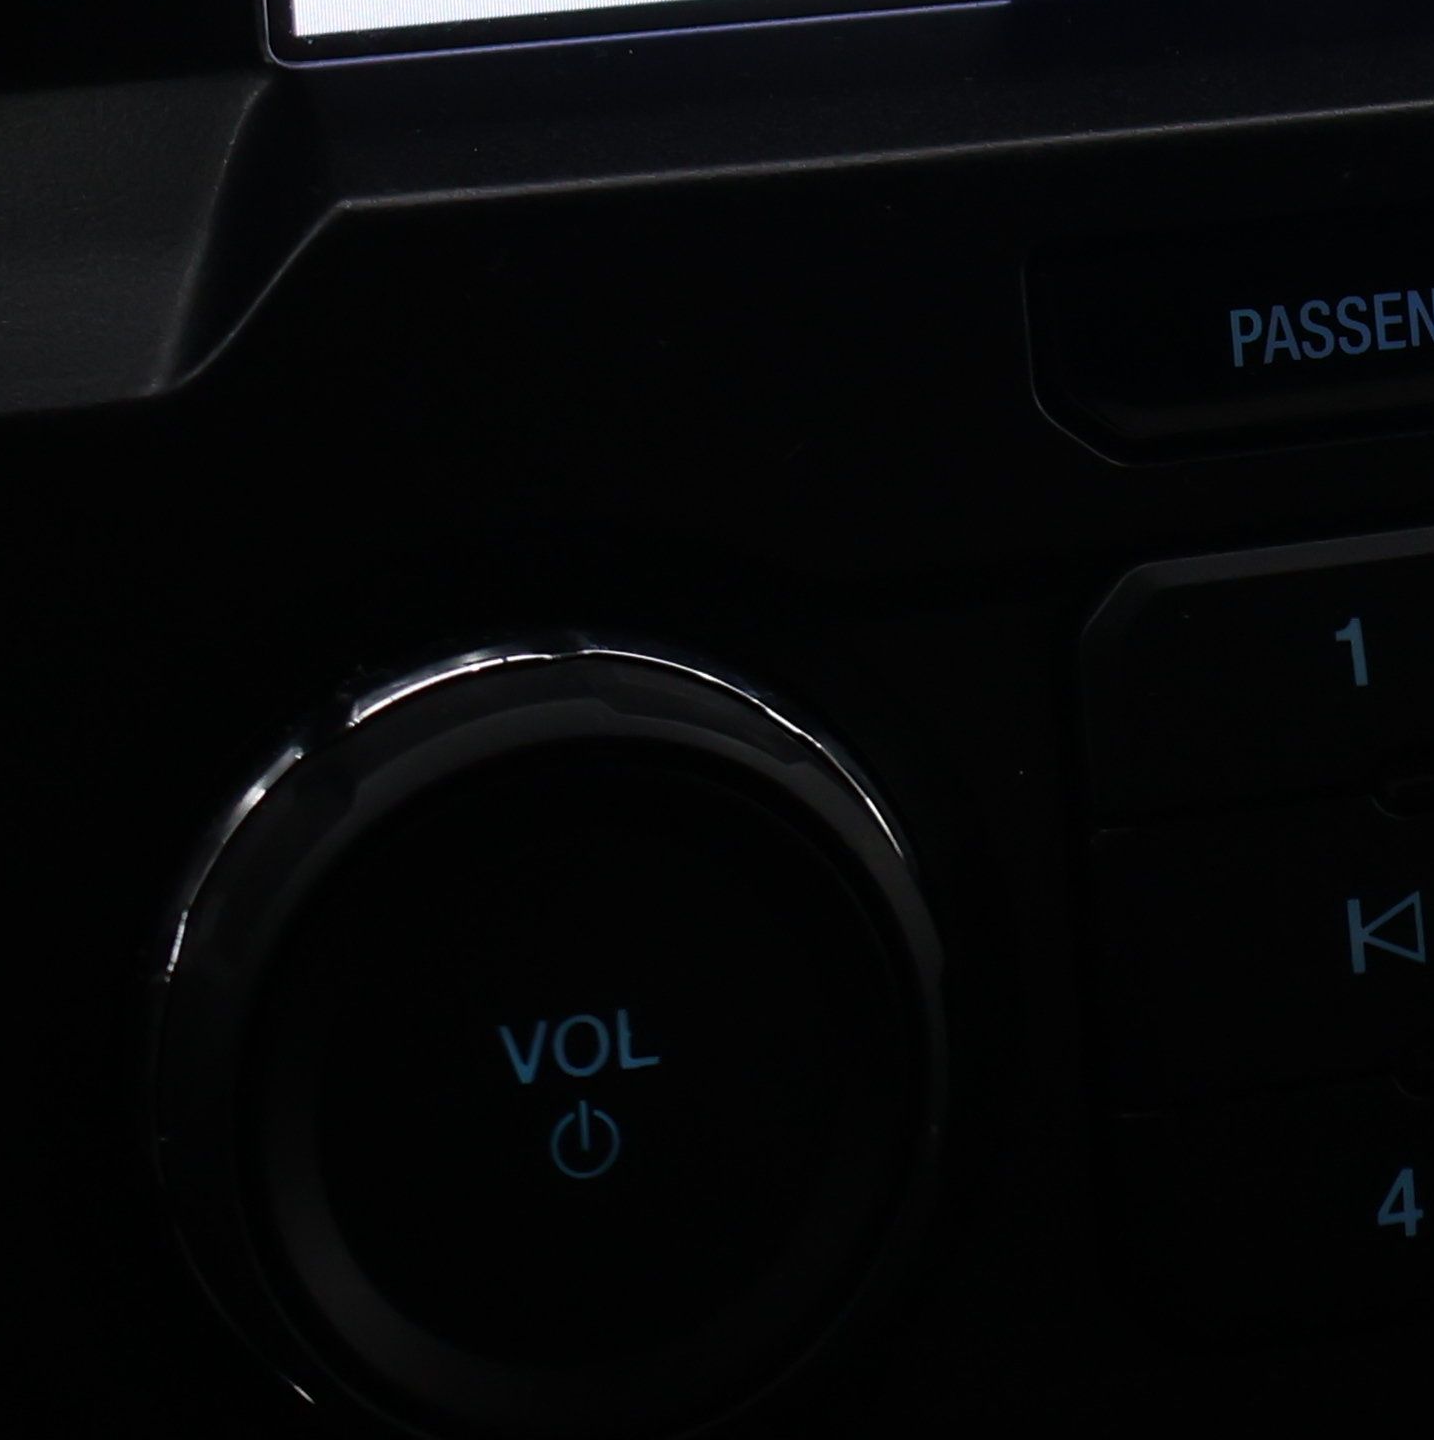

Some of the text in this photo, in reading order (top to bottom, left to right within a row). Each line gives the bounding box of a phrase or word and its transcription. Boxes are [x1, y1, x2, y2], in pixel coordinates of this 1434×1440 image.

[1335, 617, 1368, 686] 1
[500, 1009, 660, 1083] VOL
[1377, 1168, 1423, 1236] 4
